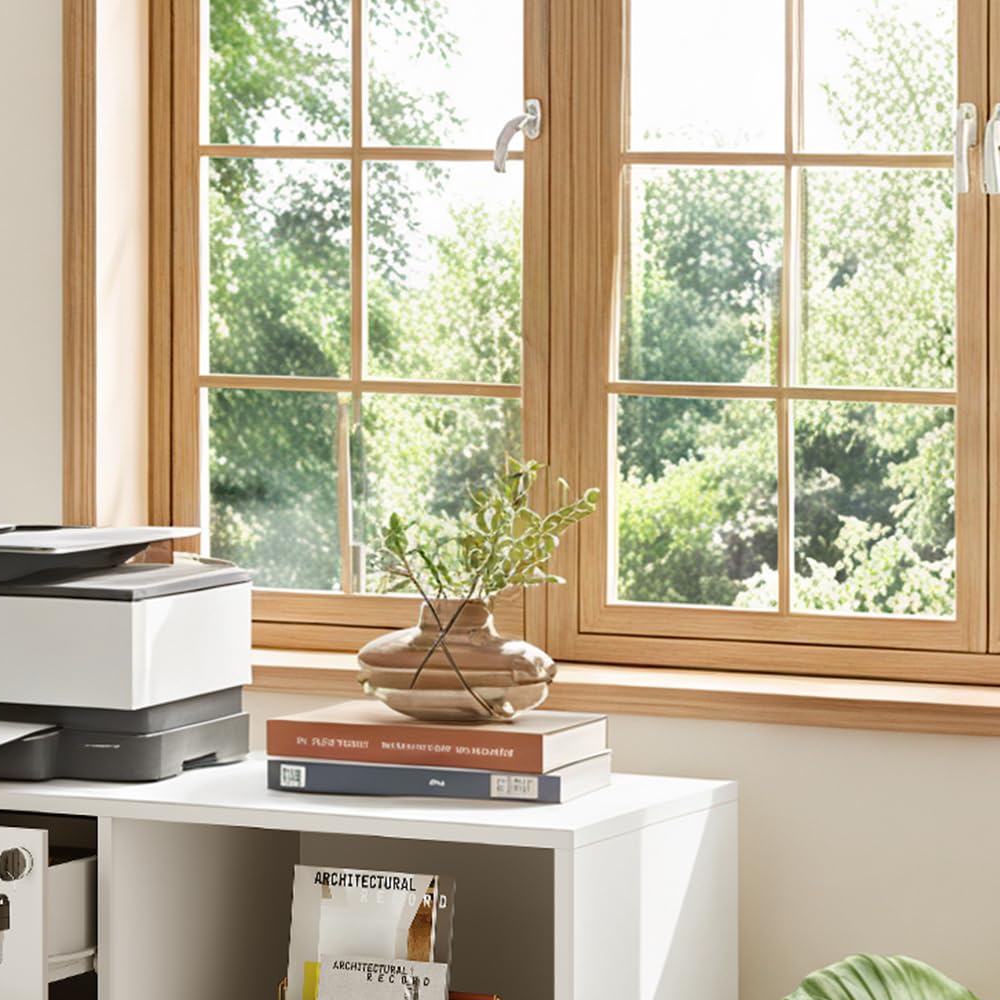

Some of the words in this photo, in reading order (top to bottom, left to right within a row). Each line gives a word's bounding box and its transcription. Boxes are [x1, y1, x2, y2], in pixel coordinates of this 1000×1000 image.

[314, 871, 416, 892] ARCHITECTURAL
[360, 889, 447, 910] REORD
[332, 960, 408, 976] ARCHITECTURAL
